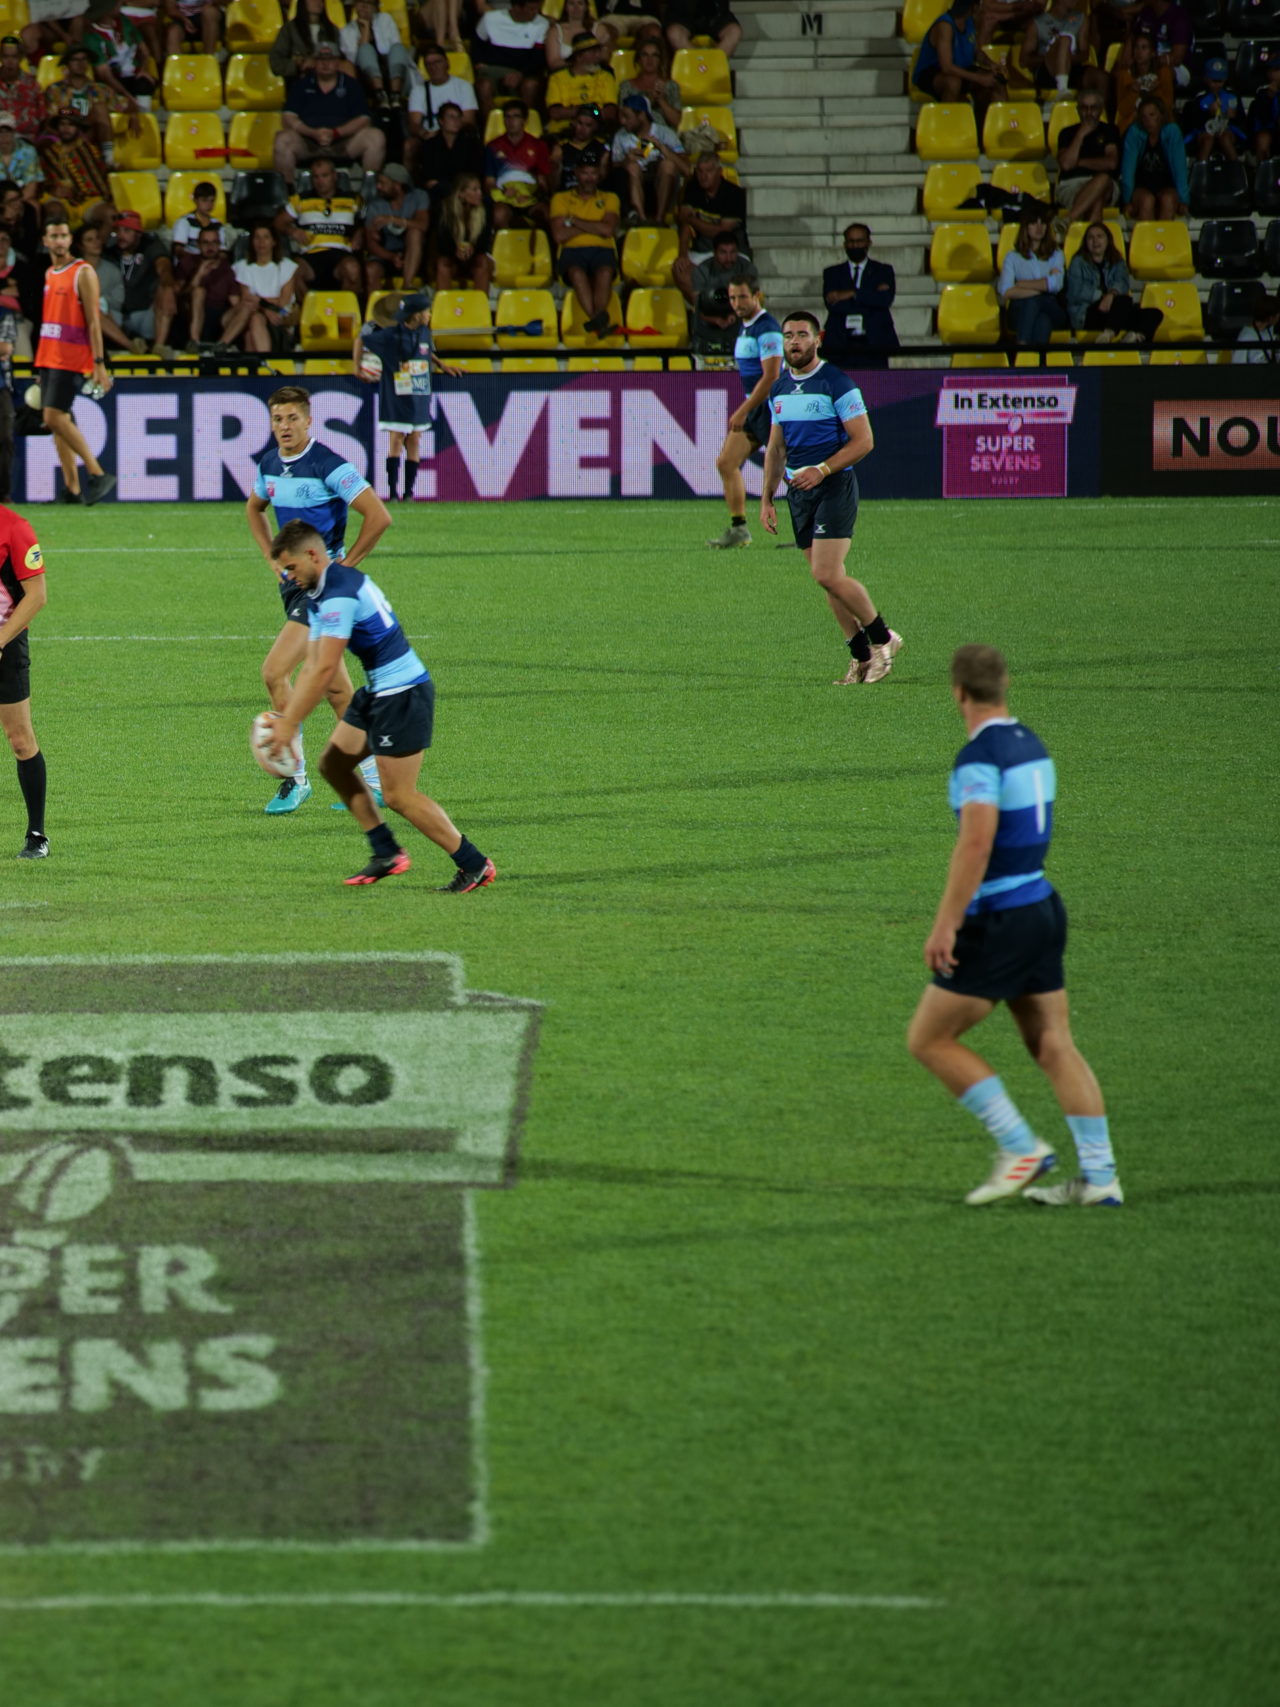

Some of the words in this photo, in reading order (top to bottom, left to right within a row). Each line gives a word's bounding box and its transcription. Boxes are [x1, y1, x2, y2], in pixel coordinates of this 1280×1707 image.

[801, 12, 823, 36] M
[953, 392, 973, 410] In
[977, 391, 1059, 410] Extenso
[976, 434, 1036, 453] SUPER
[970, 454, 1041, 472] SEVENS
